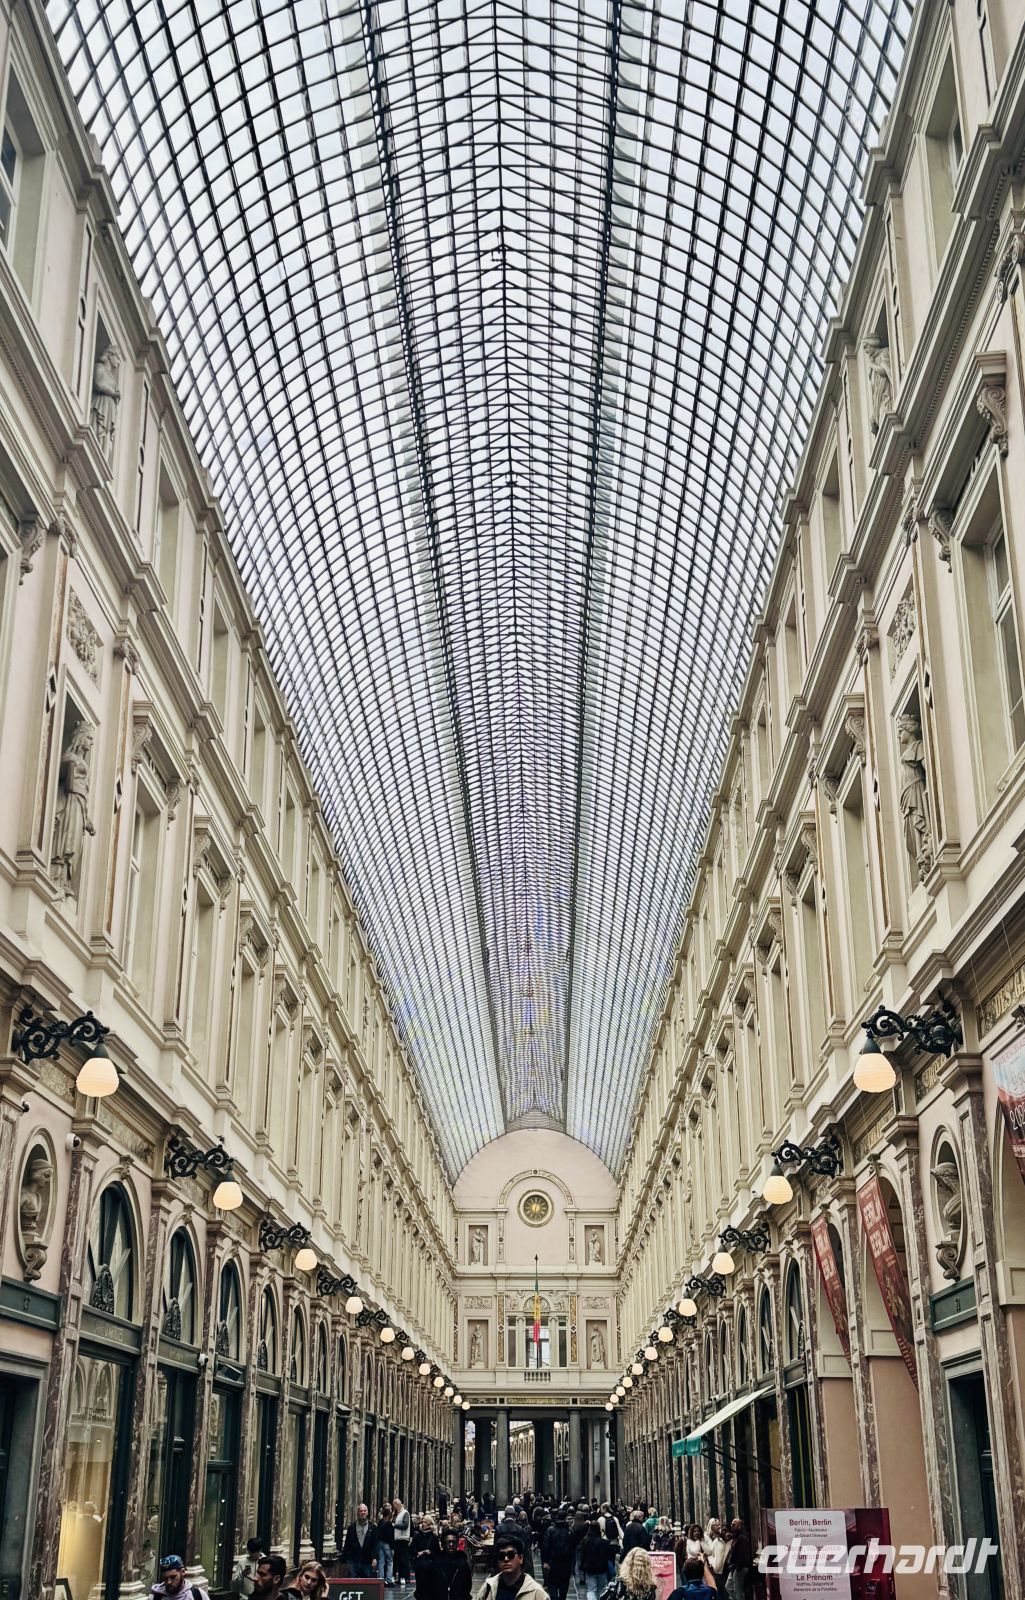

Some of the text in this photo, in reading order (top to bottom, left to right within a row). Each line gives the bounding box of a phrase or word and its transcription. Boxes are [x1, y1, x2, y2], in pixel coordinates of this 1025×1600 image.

[789, 1518, 832, 1527] Berlin, Berlin
[806, 1573, 833, 1581] Prénom
